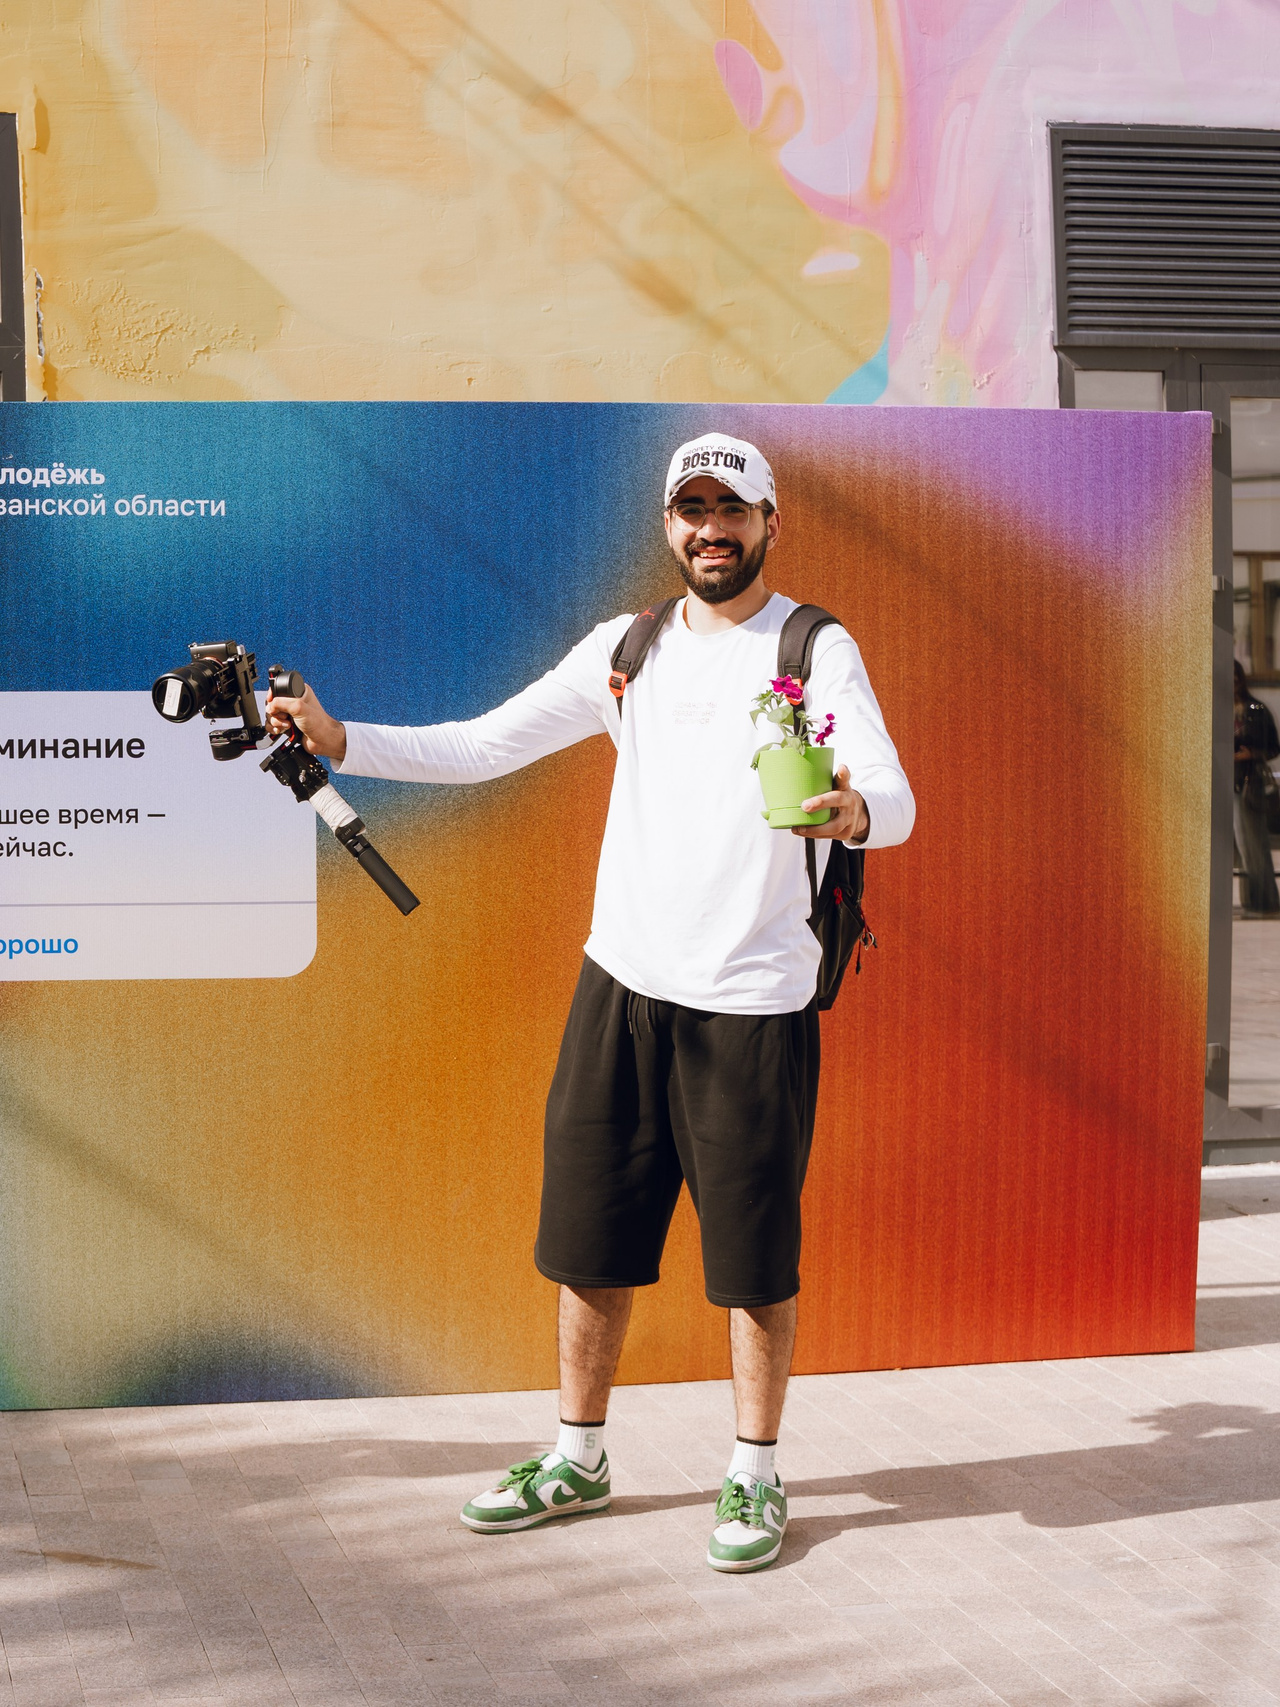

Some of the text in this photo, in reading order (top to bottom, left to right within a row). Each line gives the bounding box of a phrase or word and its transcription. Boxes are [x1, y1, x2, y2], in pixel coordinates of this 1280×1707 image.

[680, 451, 747, 473] BOSTON
[114, 496, 227, 517] области
[58, 807, 139, 830] время
